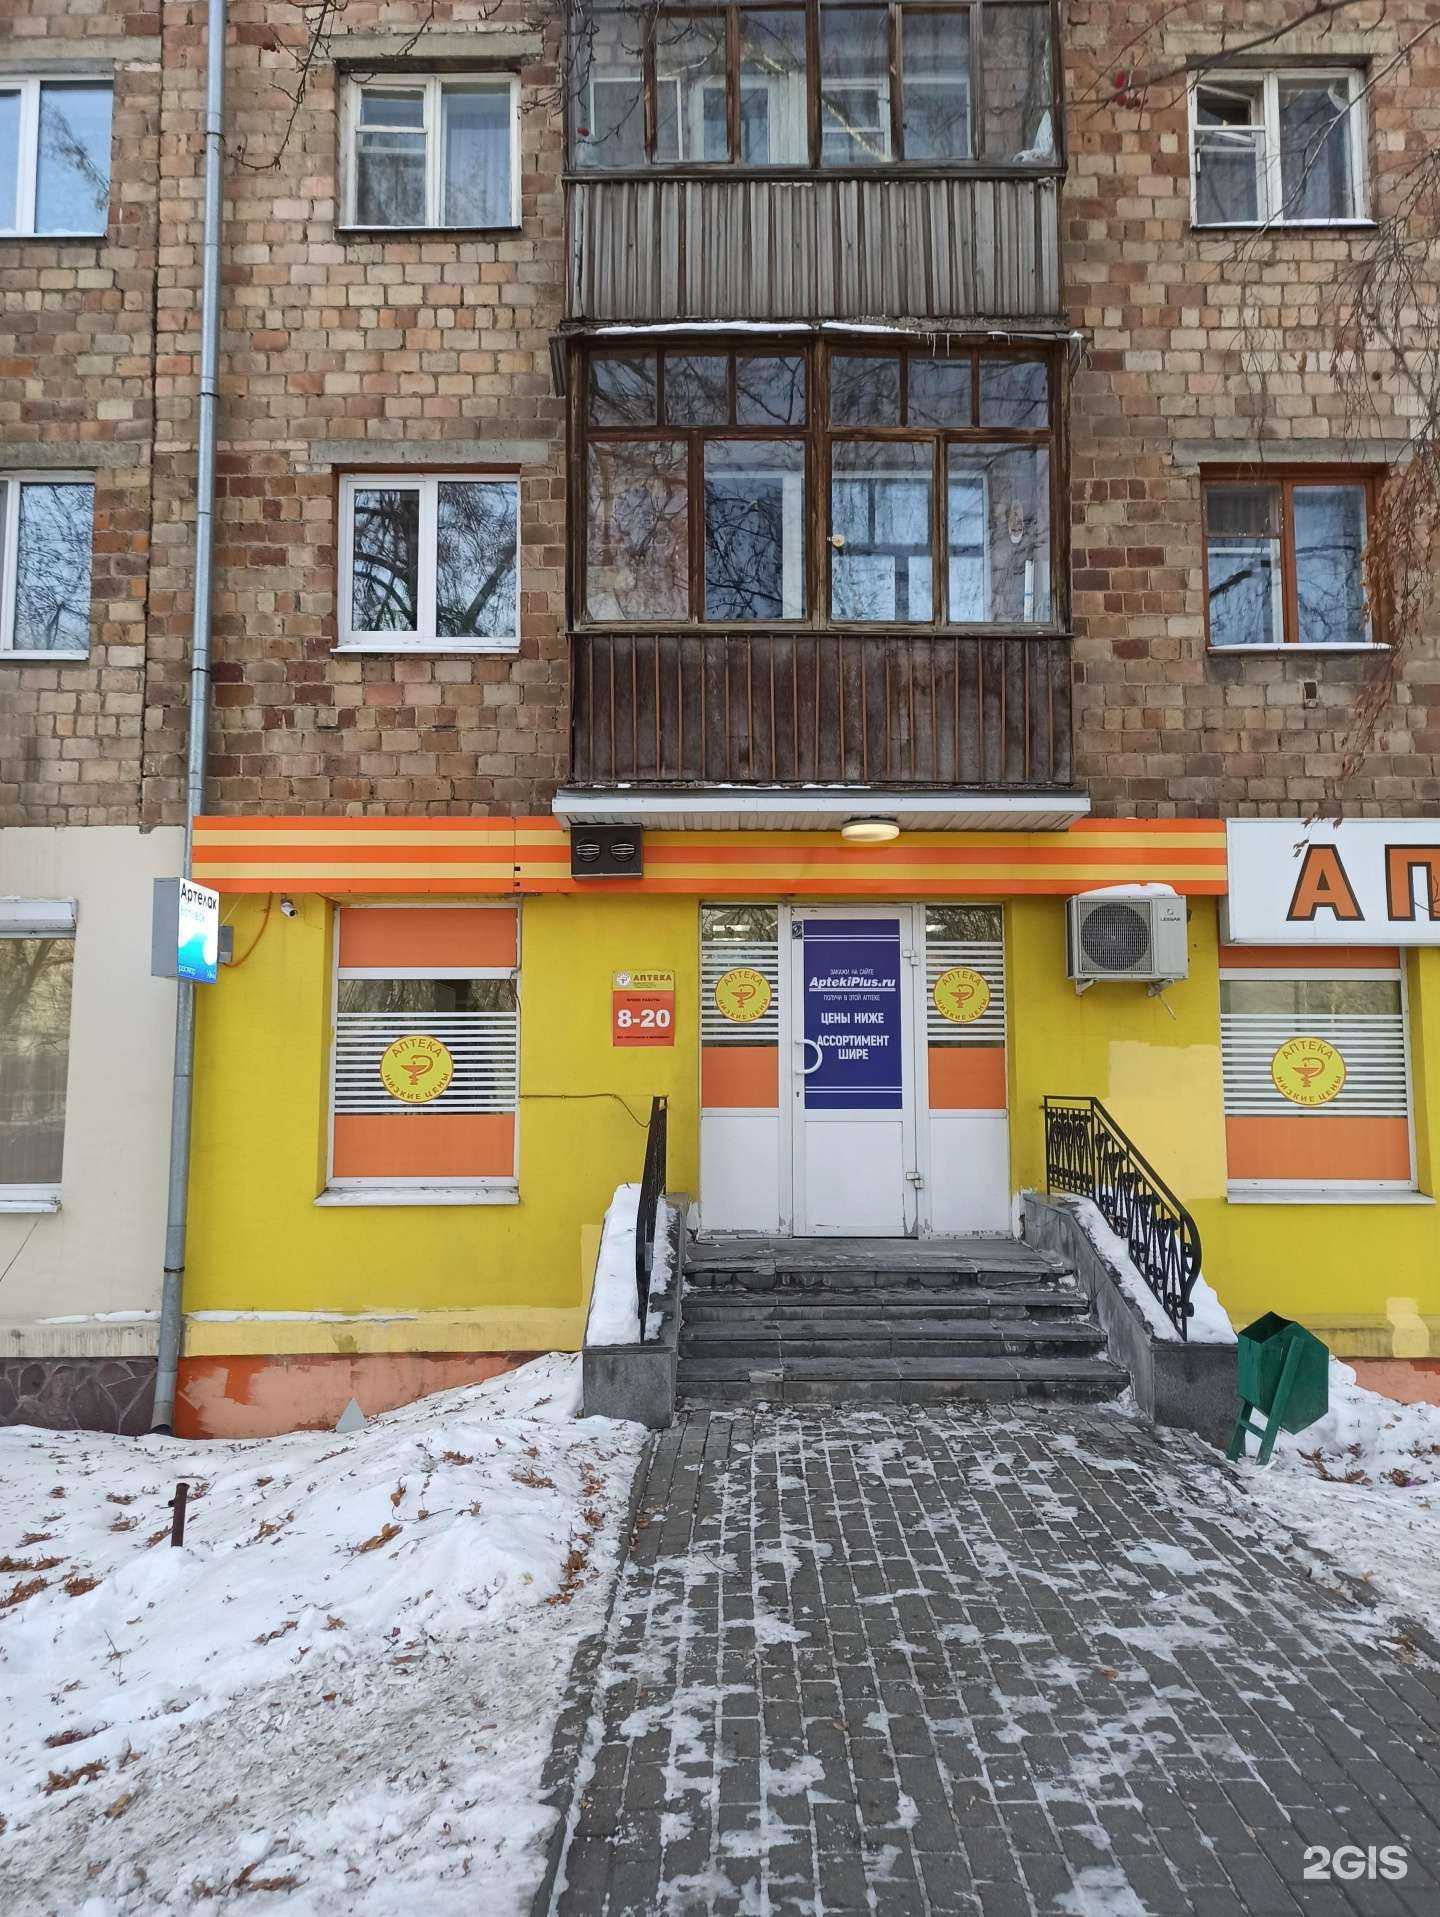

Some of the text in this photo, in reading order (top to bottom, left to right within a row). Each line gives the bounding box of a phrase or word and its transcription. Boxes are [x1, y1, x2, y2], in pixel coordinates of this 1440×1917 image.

[181, 883, 217, 910] Артелак
[724, 971, 763, 986] АПТЕКА
[809, 976, 896, 989] AptekiPlus.ru
[942, 971, 981, 986] АПТЕКА
[617, 1009, 671, 1028] 8-20
[821, 1012, 884, 1025] ЦЕНЫ НИЖЕ
[392, 1039, 442, 1058] АПТЕКА
[817, 1035, 889, 1047] АССОРТИМЕНТ
[838, 1048, 869, 1060] ШИРЕ
[1282, 1041, 1333, 1060] АПТЕКА
[385, 1073, 450, 1100] НИЗКИЕ ЦЕНЫ
[1276, 1075, 1342, 1102] НИЗКИЕ ЦЕНЫ
